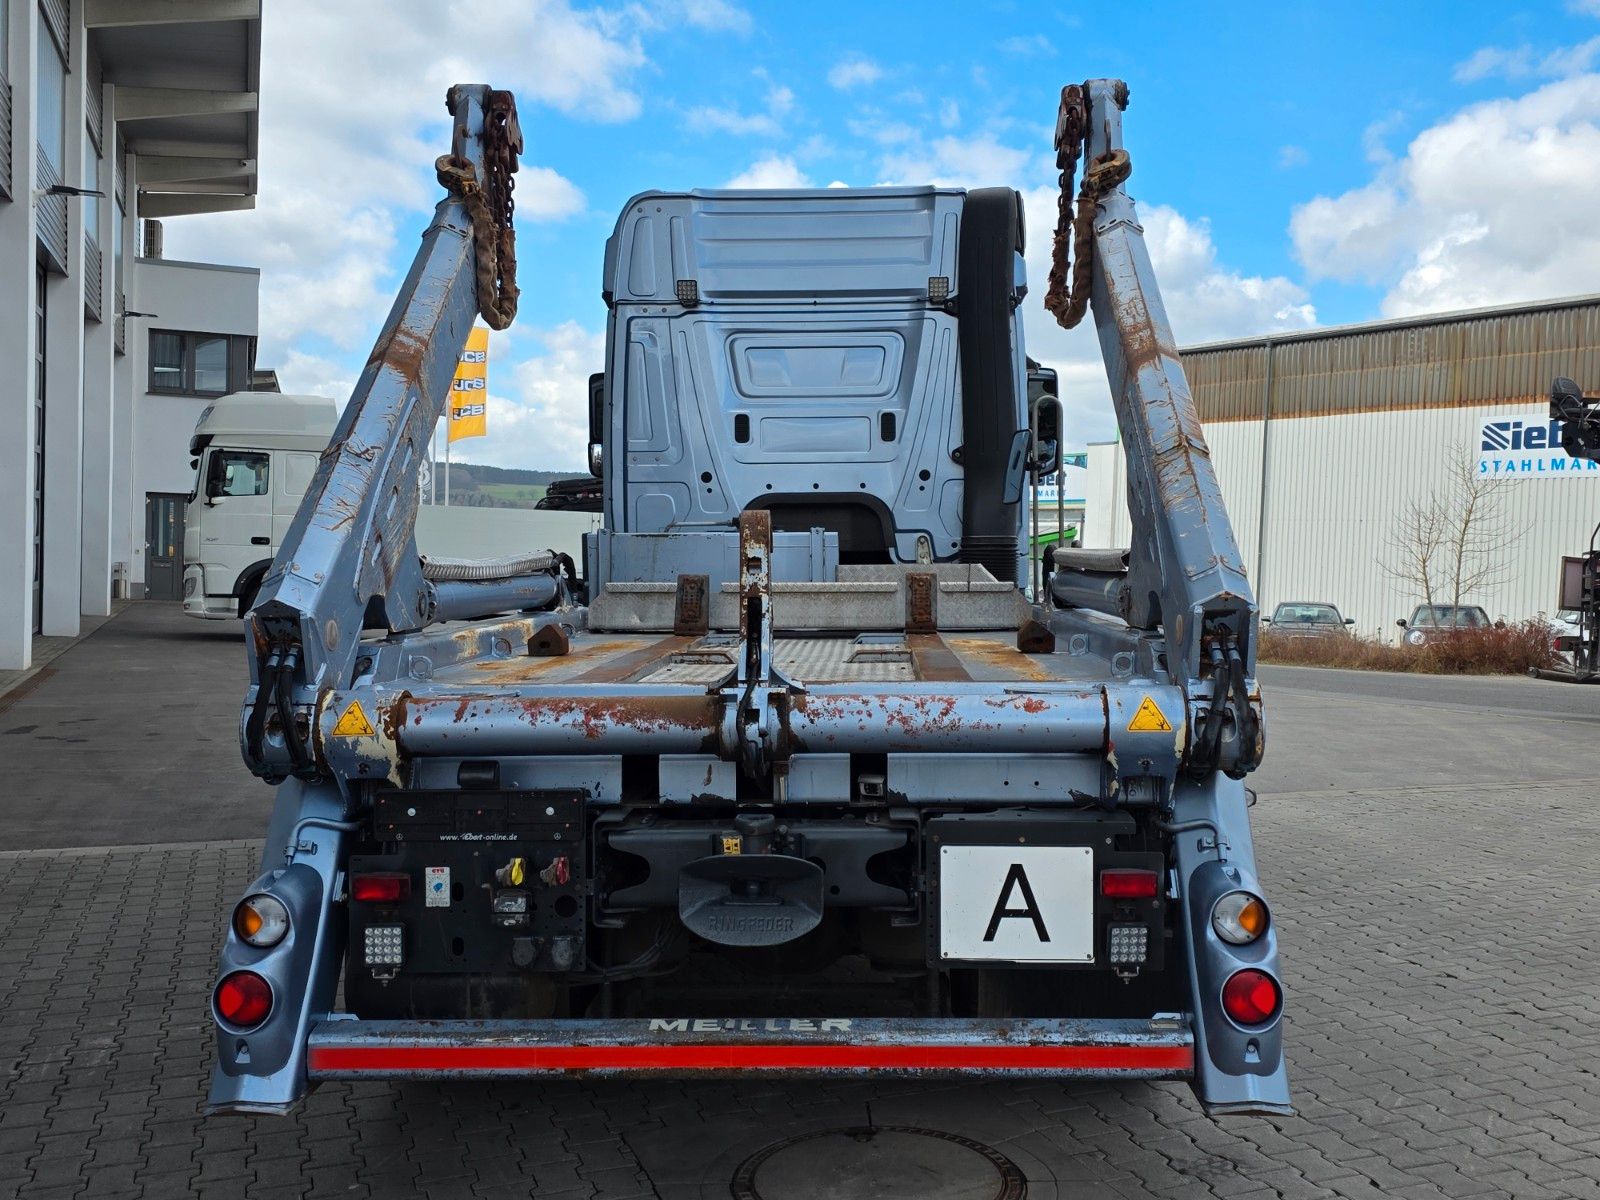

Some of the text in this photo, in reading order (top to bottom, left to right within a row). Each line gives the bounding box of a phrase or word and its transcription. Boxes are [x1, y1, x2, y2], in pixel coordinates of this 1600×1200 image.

[461, 351, 485, 362] CB
[454, 379, 485, 391] JCB
[454, 405, 484, 420] JCB
[1481, 419, 1563, 451] Sieb
[983, 863, 1051, 942] A
[707, 916, 795, 932] RINGFEDER
[648, 1018, 853, 1032] MEILLER
